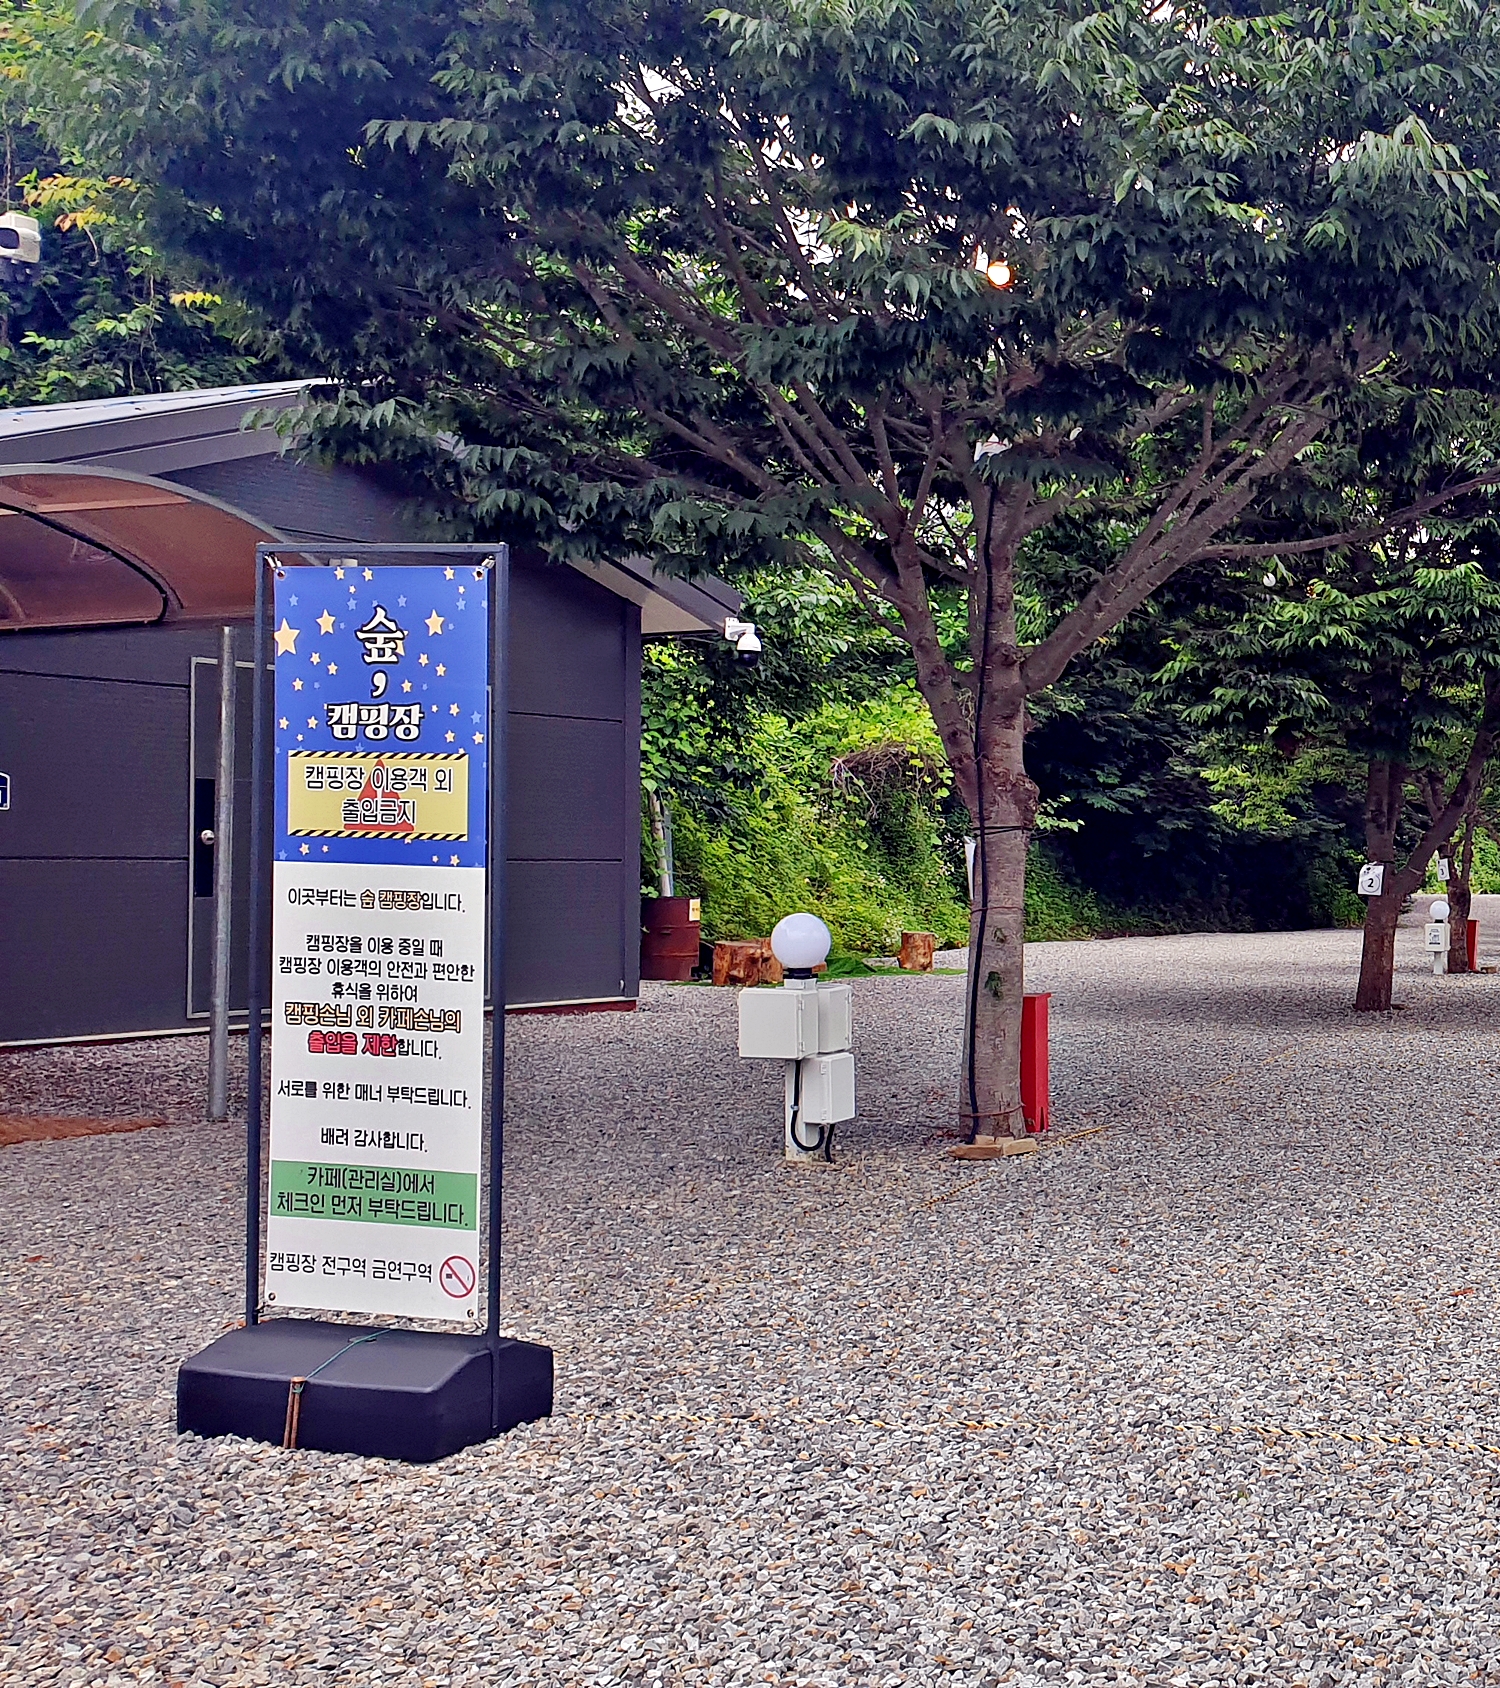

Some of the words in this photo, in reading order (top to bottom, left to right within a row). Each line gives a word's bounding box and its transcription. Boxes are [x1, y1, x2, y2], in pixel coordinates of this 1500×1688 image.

[356, 604, 406, 664] 숲
[326, 702, 424, 740] 캠핑장
[304, 765, 365, 790] 캠핑장
[372, 767, 428, 792] 이용객
[434, 768, 452, 792] 외
[342, 799, 416, 824] 출입금지
[1367, 877, 1374, 888] 2
[288, 888, 356, 908] 이곳부터는
[360, 889, 375, 909] 숲
[378, 890, 465, 912] 캠핑장입니다.
[306, 934, 363, 953] 캠핑장을
[367, 937, 393, 955] 이용
[398, 939, 425, 956] 중일
[430, 940, 443, 957] 때
[279, 956, 322, 974] 캠핑장
[327, 959, 381, 977] 이용객의
[387, 962, 427, 979] 안전과
[432, 963, 475, 982] 편안한
[331, 982, 372, 1000] 휴식을
[376, 984, 418, 1002] 위하여
[285, 1003, 352, 1027] 캠핑손님
[356, 1006, 374, 1027] 외
[378, 1007, 461, 1033] 카페손님의
[308, 1032, 357, 1054] 출입을
[362, 1035, 442, 1059] 제한합니다.
[278, 1080, 317, 1098] 서로를
[322, 1083, 350, 1099] 위한
[355, 1084, 382, 1102] 매너
[387, 1086, 471, 1109] 부탁드립니다.
[321, 1128, 349, 1146] 배려
[354, 1130, 428, 1152] 감사합니다.
[307, 1167, 435, 1195] 카페(관리실)에서
[278, 1192, 325, 1214] 체크인
[332, 1195, 362, 1216] 먼저
[368, 1198, 468, 1226] 부탁드립니다.
[270, 1252, 316, 1273] 캠핑장
[322, 1256, 366, 1278] 전구역
[372, 1260, 432, 1283] 금연구역
